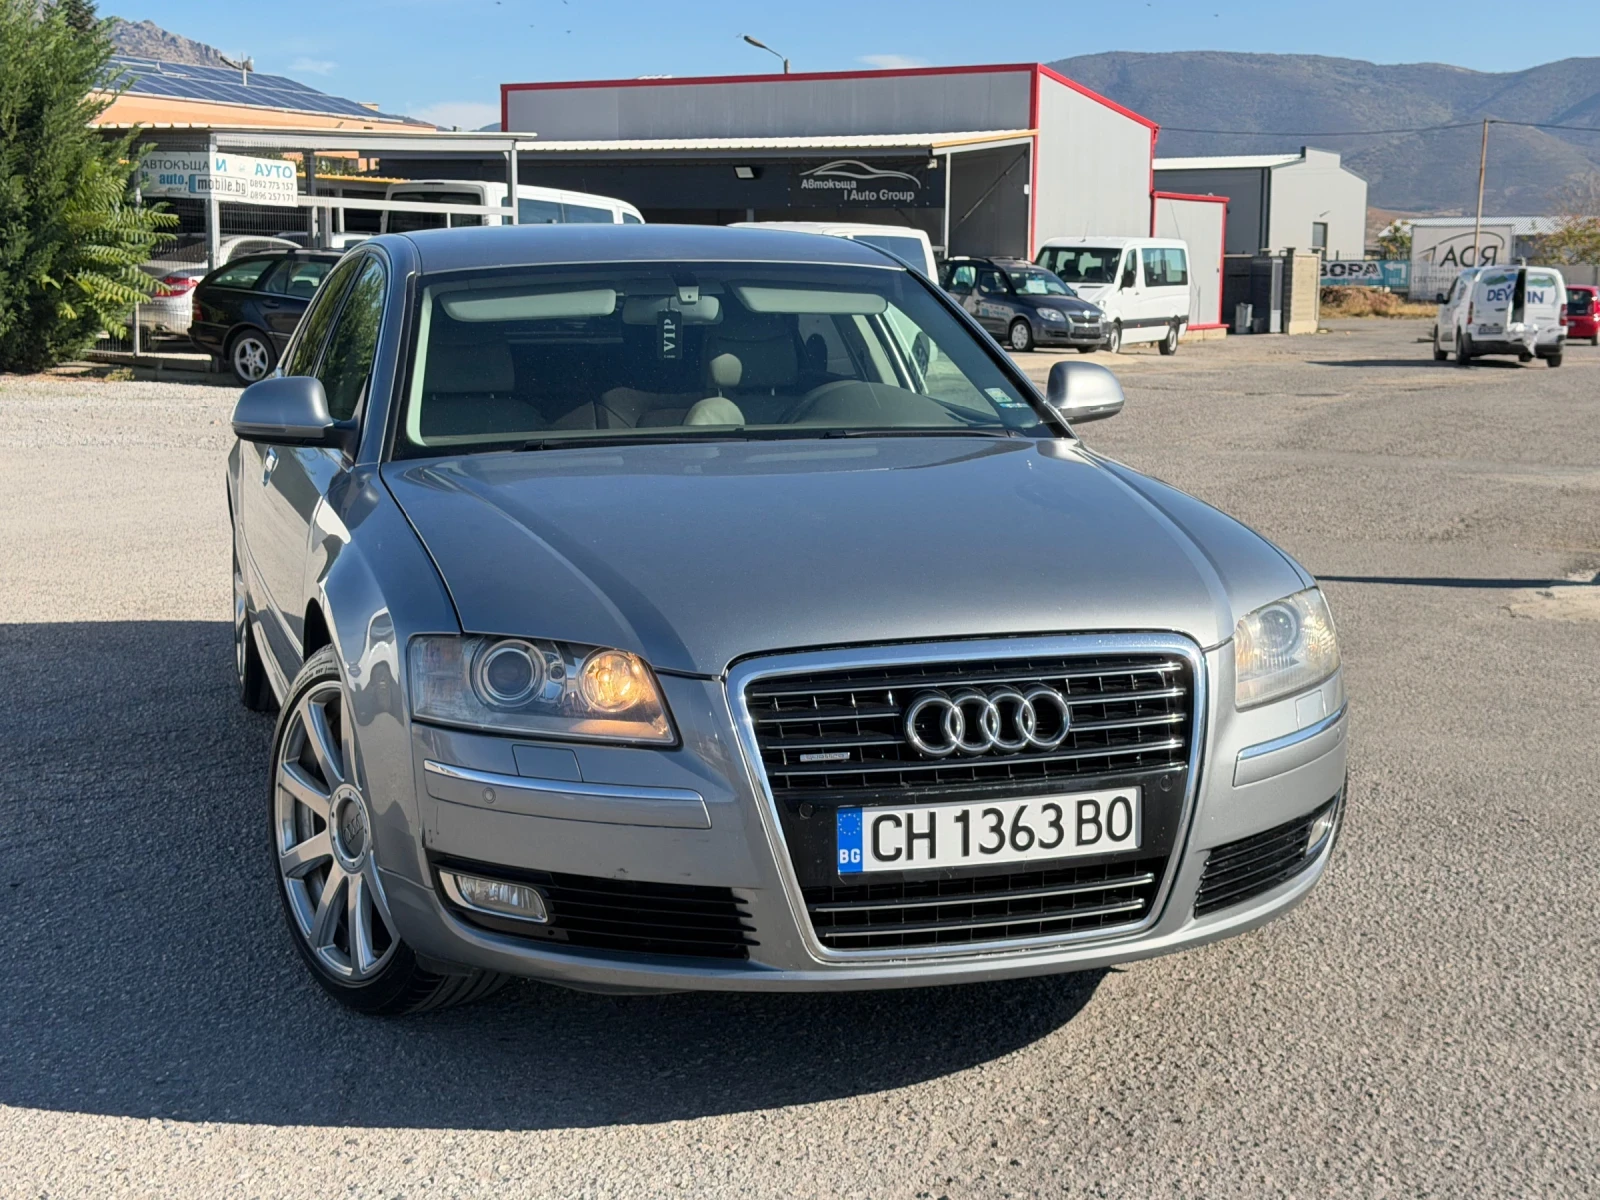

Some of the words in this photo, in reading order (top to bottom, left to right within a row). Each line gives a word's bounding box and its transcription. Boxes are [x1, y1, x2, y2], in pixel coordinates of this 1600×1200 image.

[141, 159, 210, 172] АВТОКЪЩА
[215, 158, 227, 172] И
[254, 163, 293, 179] АУТО
[197, 177, 247, 195] mobile.bg
[249, 179, 267, 188] 0892
[268, 181, 280, 190] 773
[282, 182, 294, 191] 157
[800, 179, 857, 190] Автокъща
[249, 190, 267, 200] 0896
[267, 192, 281, 201] 257
[282, 193, 294, 202] 171
[849, 189, 877, 201] Auto
[879, 189, 915, 203] Group
[663, 318, 676, 352] VIP
[871, 810, 937, 863] CH
[953, 801, 1065, 858] 1363
[839, 848, 861, 865] BG
